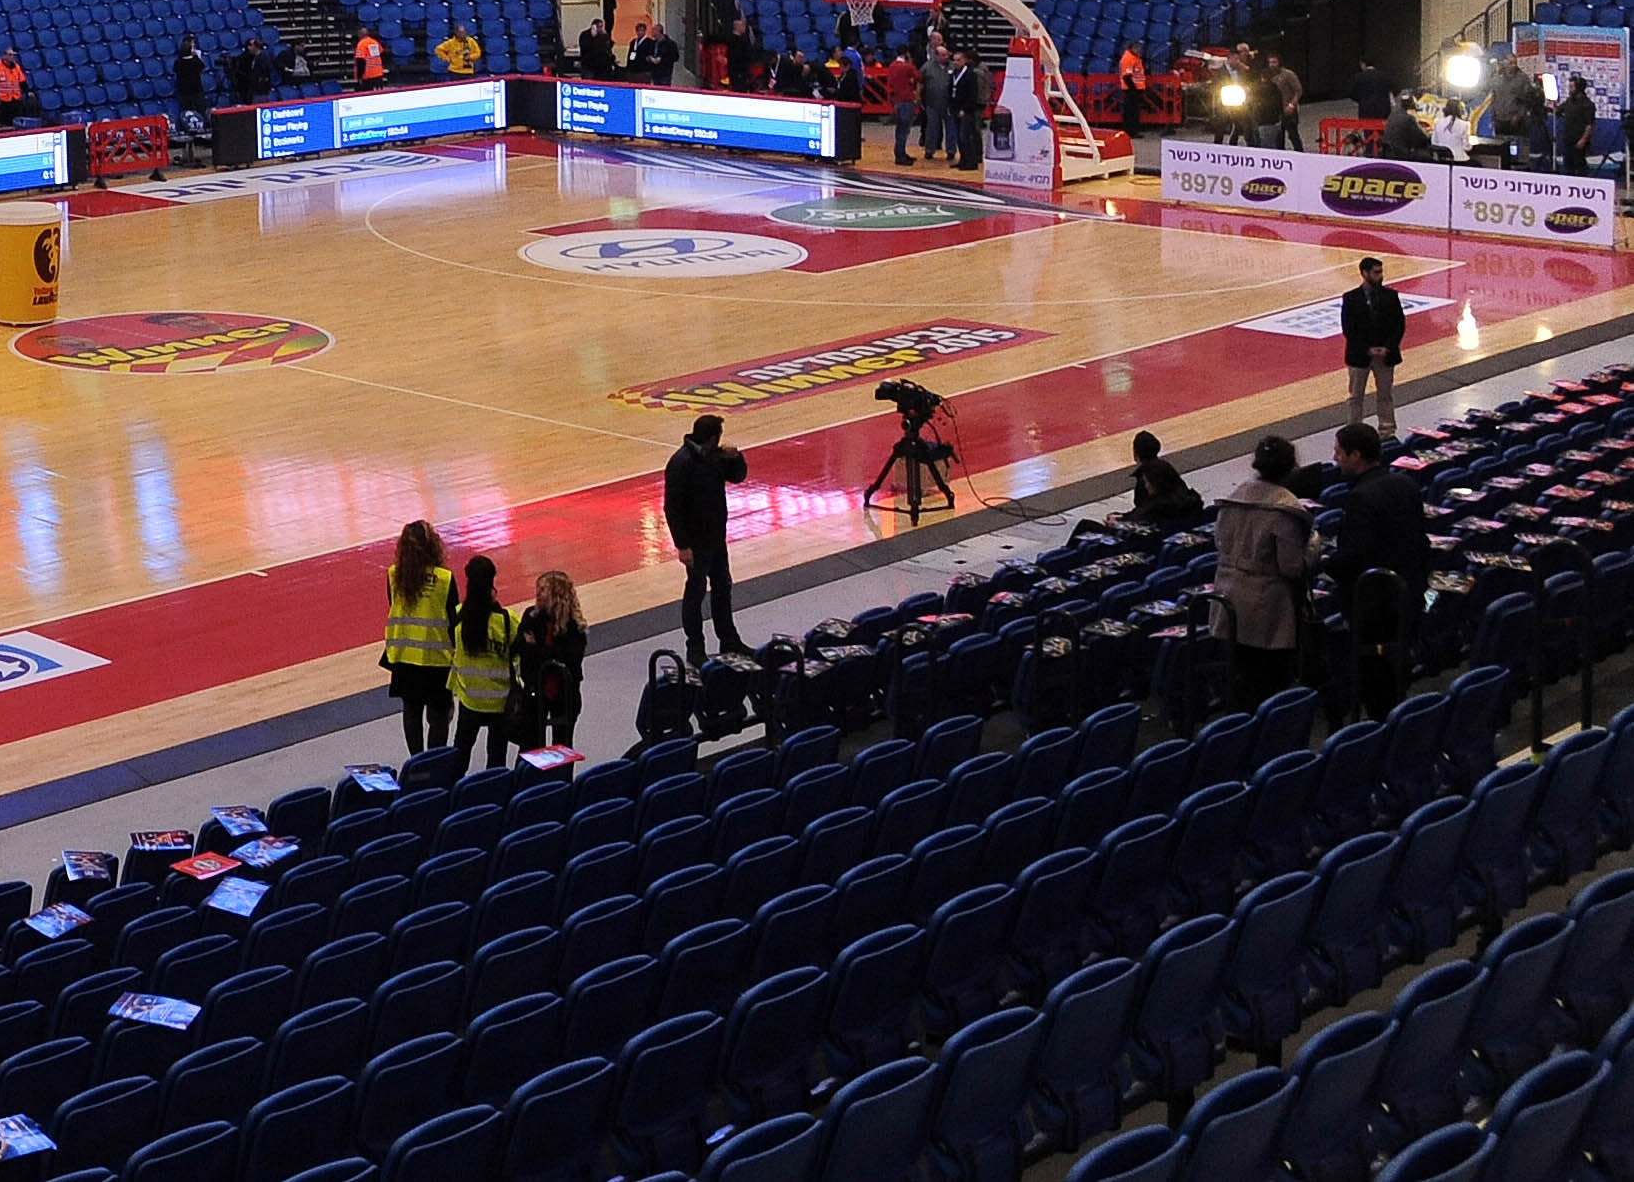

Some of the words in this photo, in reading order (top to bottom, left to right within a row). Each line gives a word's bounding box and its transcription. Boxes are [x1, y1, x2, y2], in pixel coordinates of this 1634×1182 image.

[1168, 149, 1201, 163] כושר
[1206, 154, 1255, 168] מועדוני
[1260, 158, 1293, 171] רשת
[248, 165, 372, 184] בנק
[1460, 176, 1498, 189] כושר
[138, 179, 248, 200] יהב
[1242, 182, 1287, 195] space
[1322, 174, 1426, 202] space
[1504, 181, 1561, 197] מועדוני
[1569, 186, 1607, 201] רשת
[1546, 211, 1599, 226] space
[582, 247, 786, 273] HYUNDAI
[46, 320, 295, 368] Winner
[874, 325, 970, 350] גביע
[912, 327, 1019, 355] 2015
[736, 342, 878, 381] המדינה
[663, 348, 928, 408] Winner
